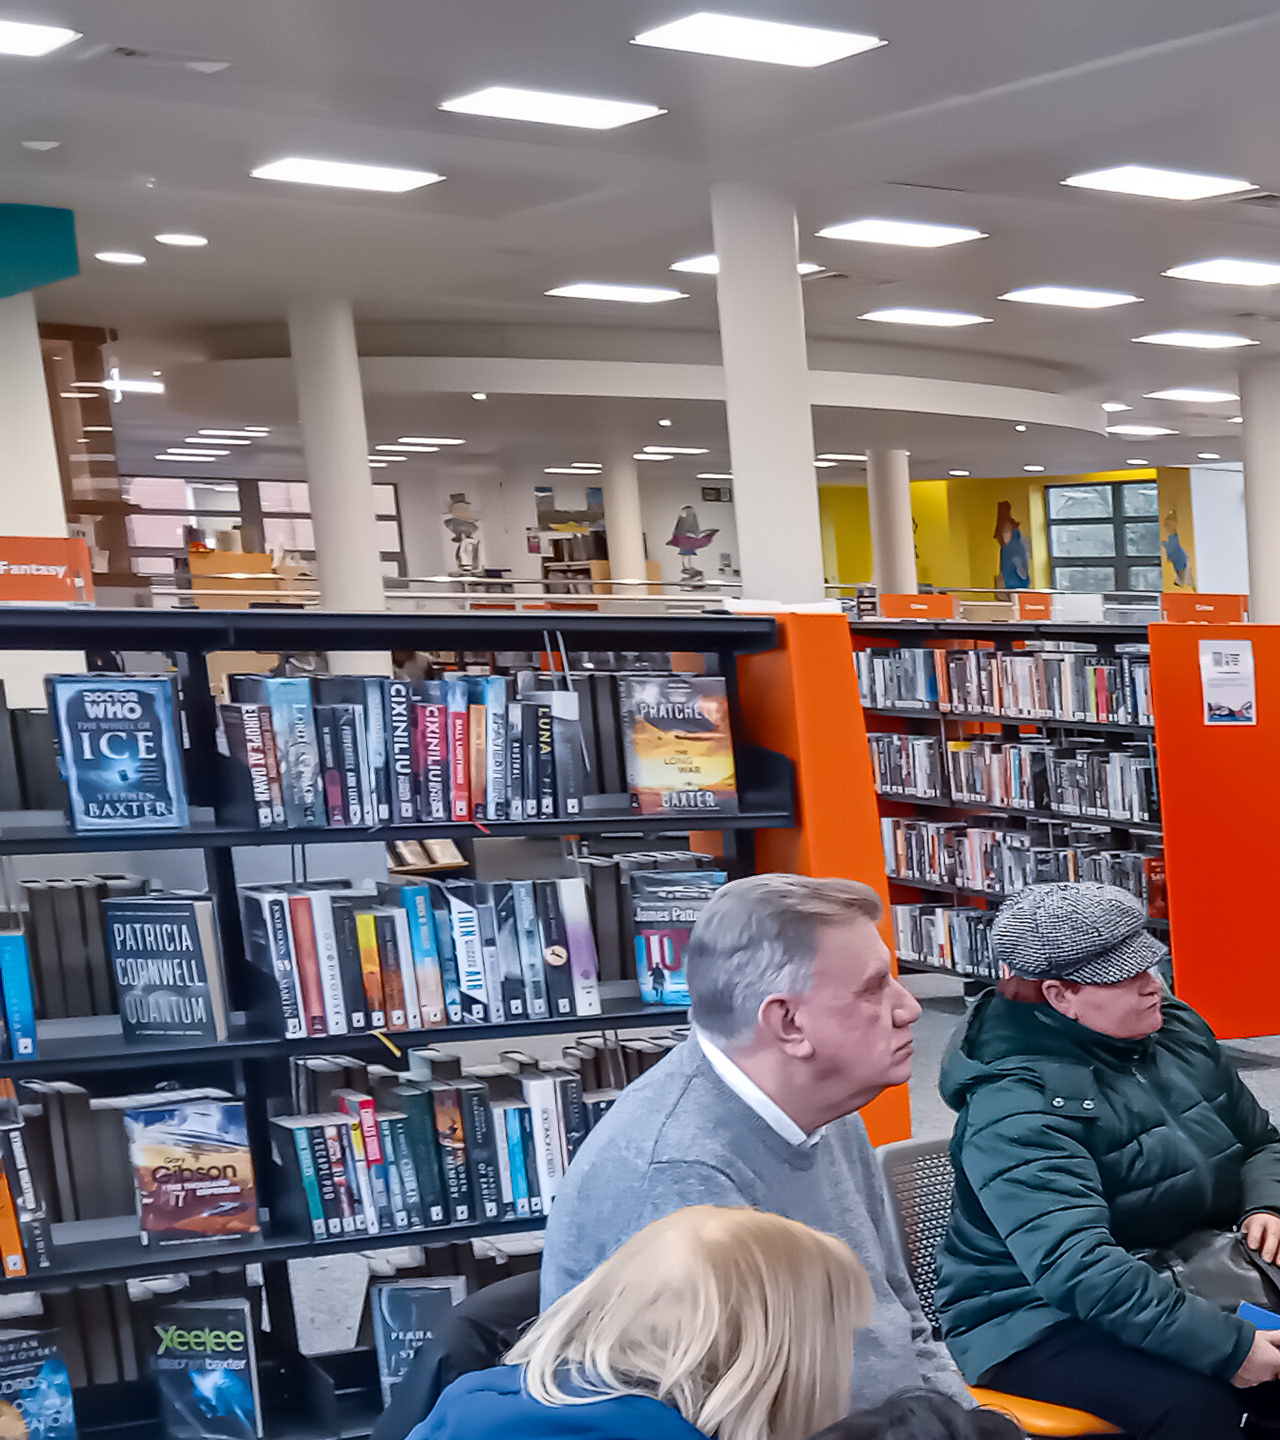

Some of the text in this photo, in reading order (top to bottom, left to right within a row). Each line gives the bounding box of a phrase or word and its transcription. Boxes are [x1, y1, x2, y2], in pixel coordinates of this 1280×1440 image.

[0, 560, 68, 579] Fantasy
[83, 701, 143, 720] WHO
[639, 702, 712, 720] PRATCHE
[241, 704, 265, 751] EUROPE
[538, 707, 552, 754] LUNA
[79, 731, 158, 760] ICE
[250, 768, 271, 802] DAWN
[88, 801, 170, 817] BAXTER
[634, 906, 671, 922] James
[113, 923, 194, 952] PATRICIA
[116, 957, 208, 987] CORNWELL
[125, 996, 208, 1024] QUANTUM
[152, 1162, 238, 1184] Gibson
[445, 1155, 459, 1199] MEMORY
[153, 1325, 246, 1355] Xeelee
